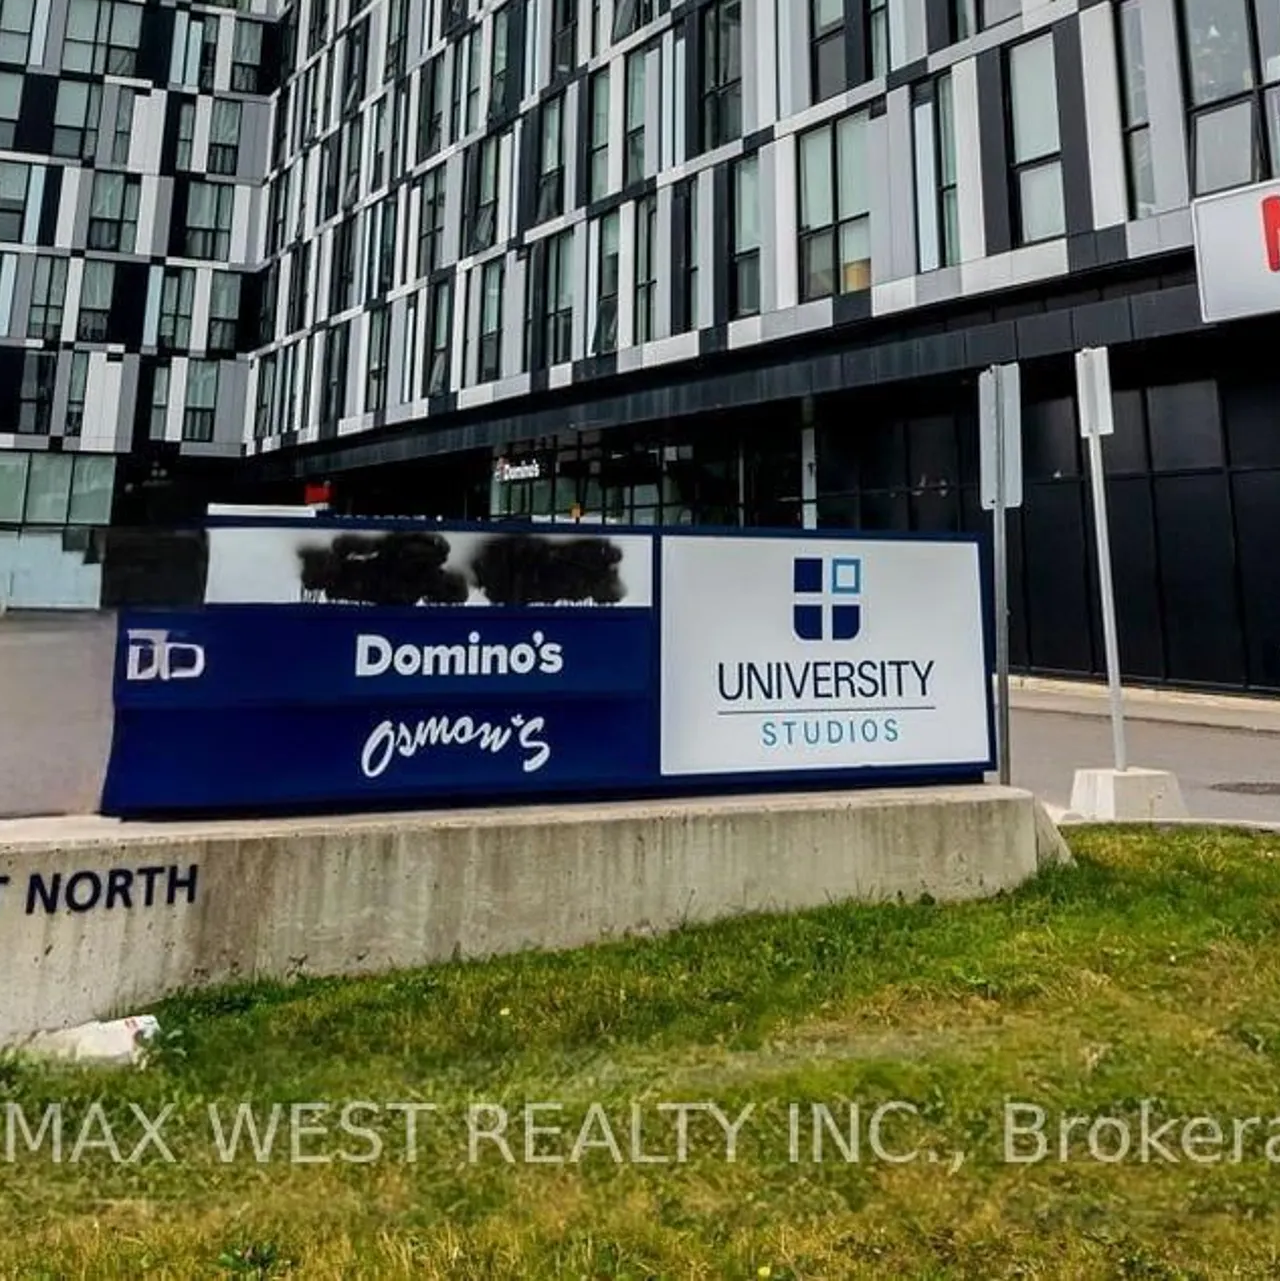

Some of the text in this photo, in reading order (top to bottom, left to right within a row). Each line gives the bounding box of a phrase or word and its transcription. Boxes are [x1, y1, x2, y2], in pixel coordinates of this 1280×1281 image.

[355, 631, 564, 677] Domino's
[718, 660, 935, 700] UNIVERSITY
[762, 719, 899, 746] STUDIOS
[25, 864, 198, 915] NORTH
